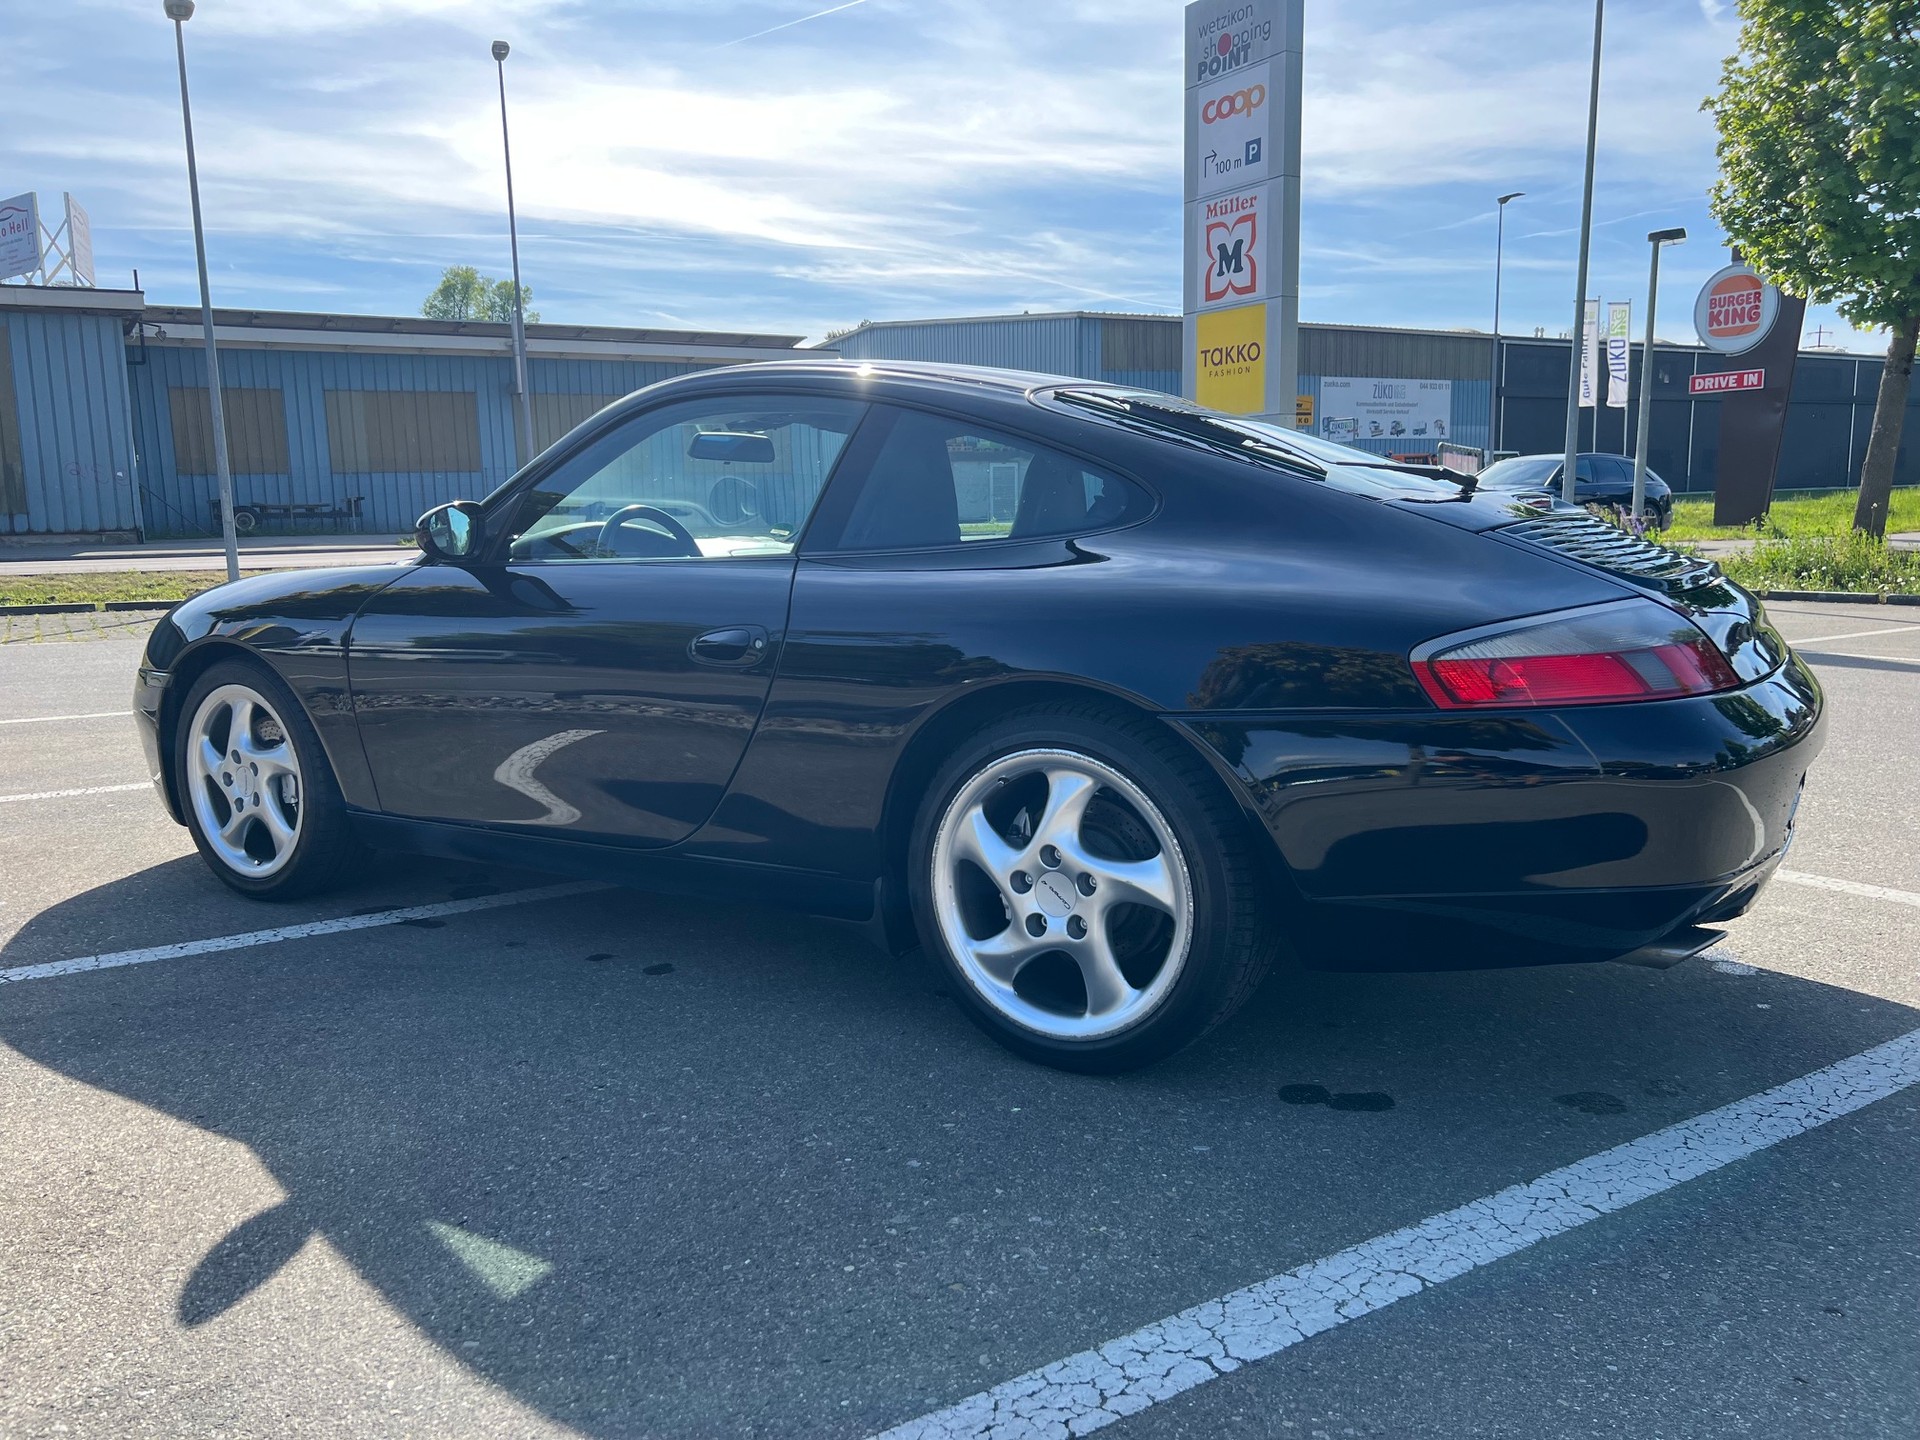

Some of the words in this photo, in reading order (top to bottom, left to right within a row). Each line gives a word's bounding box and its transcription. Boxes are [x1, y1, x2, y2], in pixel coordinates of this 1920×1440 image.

[1198, 4, 1253, 39] wetzikon
[1197, 42, 1251, 82] POINT
[1202, 84, 1265, 124] coop
[1249, 143, 1258, 161] P
[1215, 159, 1231, 175] 100
[1234, 158, 1242, 169] m
[1206, 195, 1257, 220] Müller
[1216, 239, 1244, 277] M
[1709, 291, 1762, 310] BURGER
[1708, 305, 1761, 328] KING
[1209, 366, 1251, 378] FASHION
[1694, 375, 1738, 391] DRIVE
[1743, 373, 1758, 386] IN
